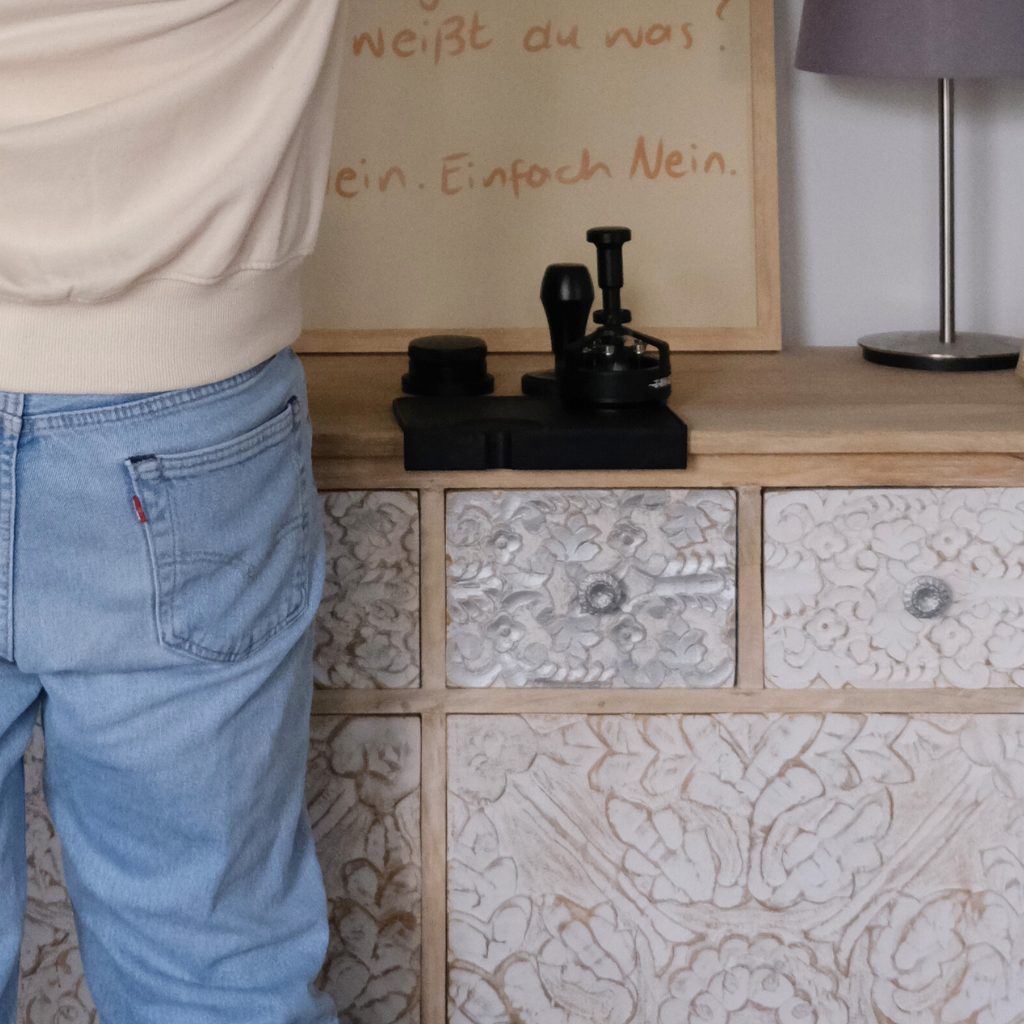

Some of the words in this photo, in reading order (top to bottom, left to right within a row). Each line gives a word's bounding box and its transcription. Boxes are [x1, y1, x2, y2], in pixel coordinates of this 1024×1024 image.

[523, 19, 581, 53] du
[327, 159, 425, 199] ein.
[441, 149, 611, 199] Einfach
[630, 135, 736, 180] Nein.
